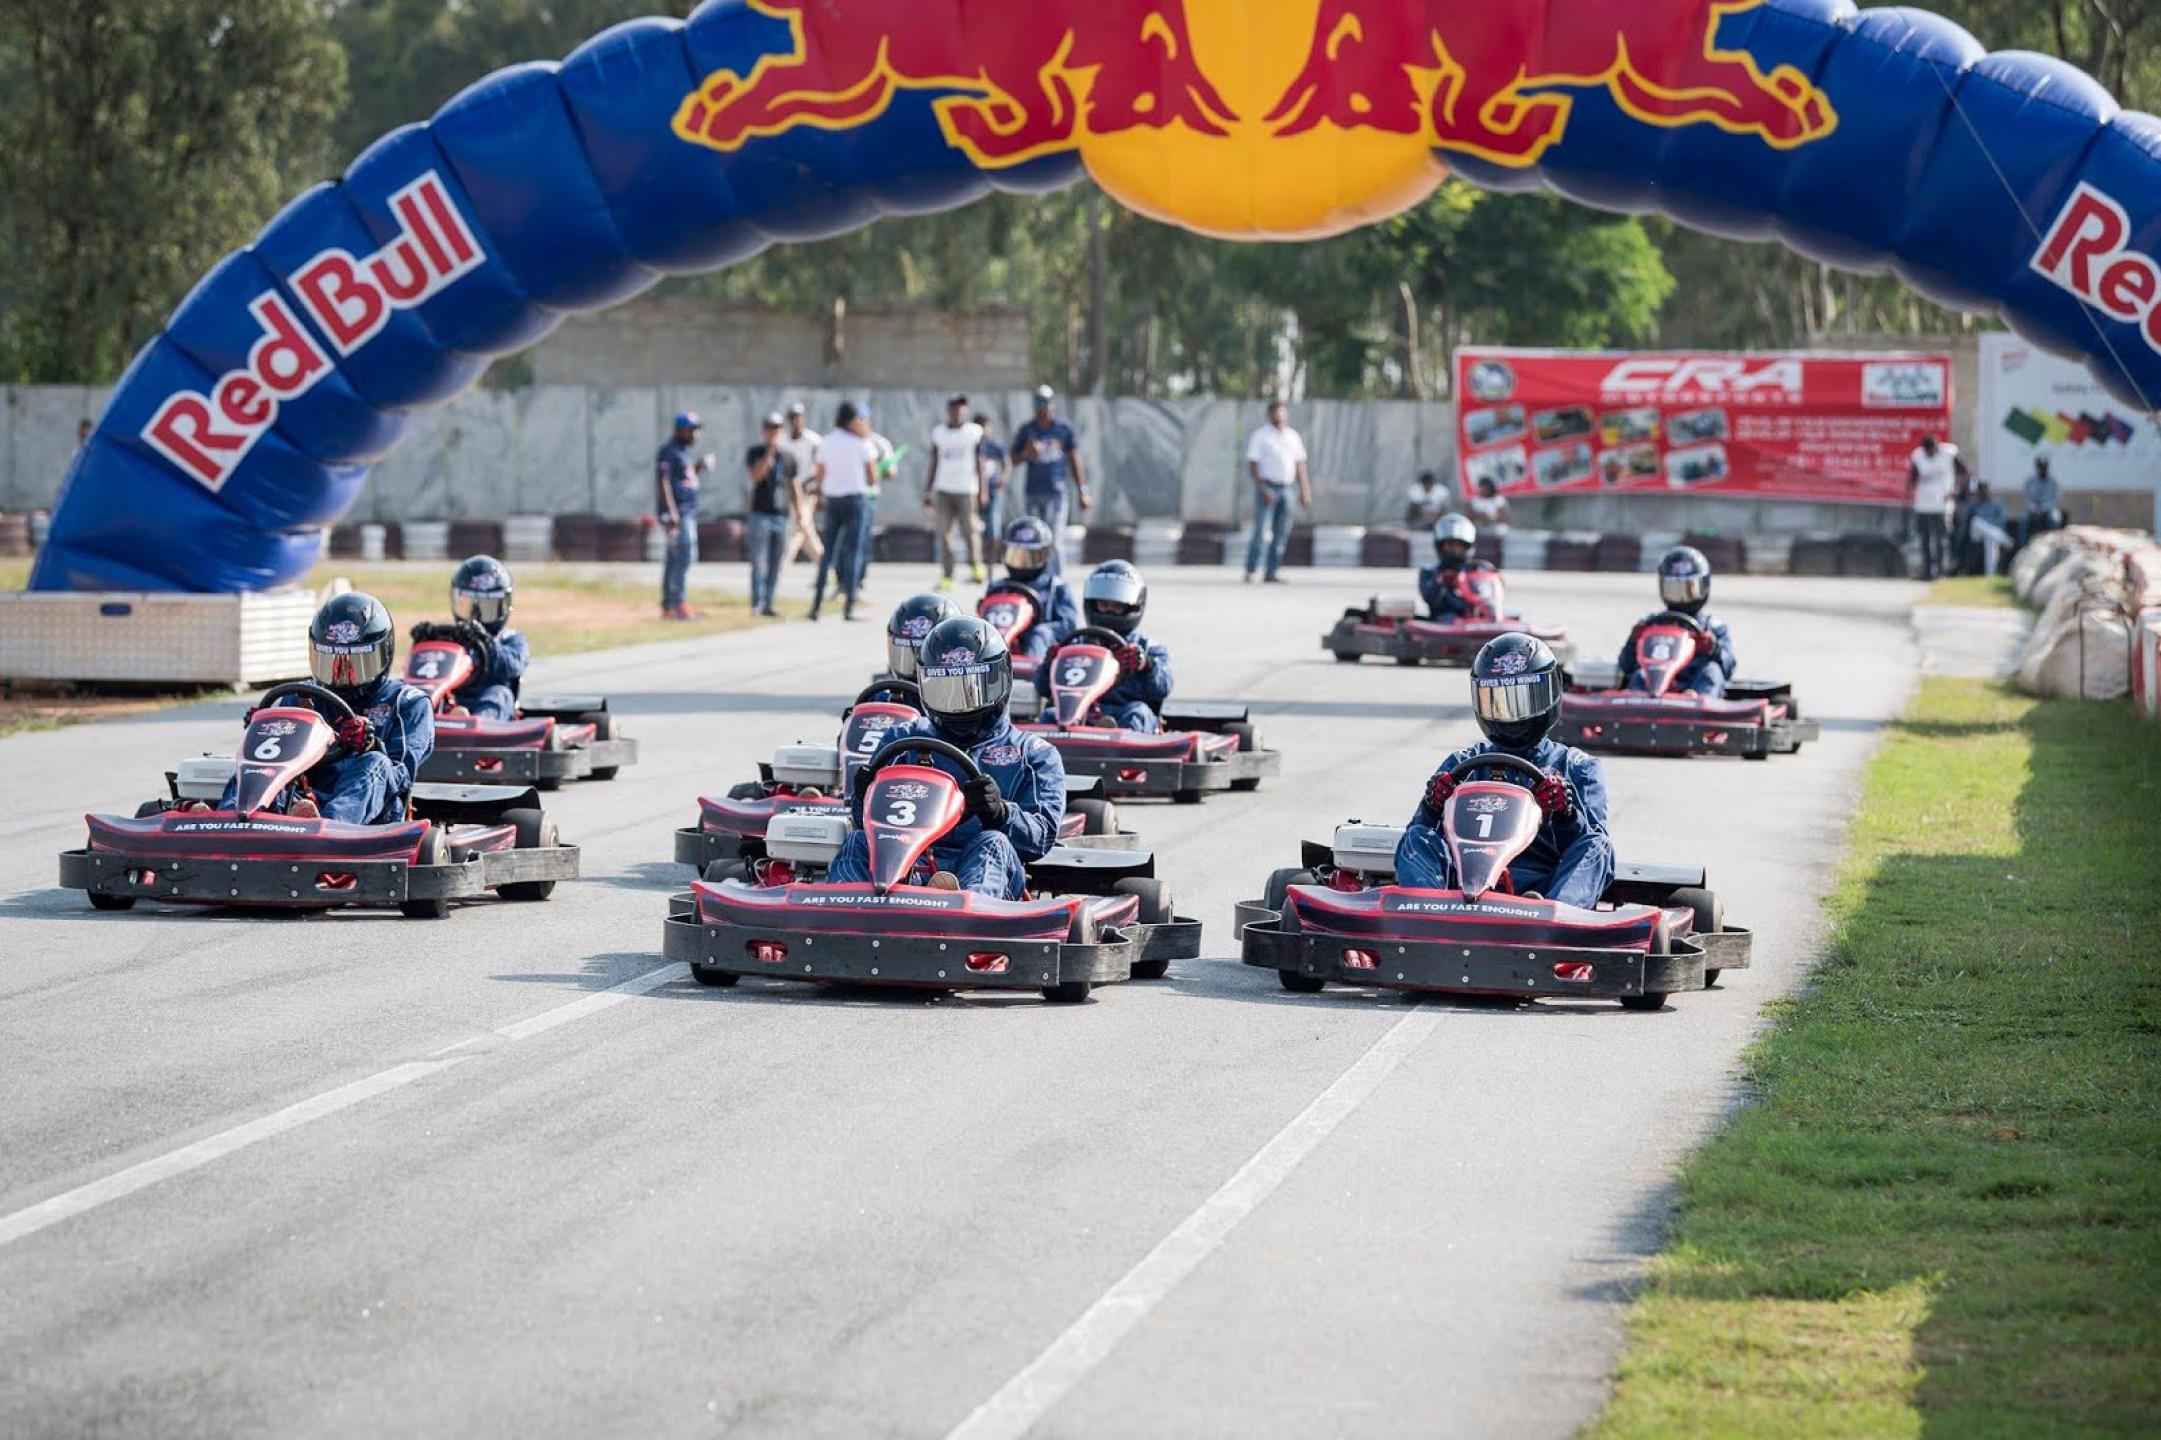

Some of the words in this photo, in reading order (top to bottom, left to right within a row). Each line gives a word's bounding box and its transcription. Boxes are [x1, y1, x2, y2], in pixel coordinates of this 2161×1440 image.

[149, 297, 326, 483] Red
[296, 179, 475, 350] Bull
[1601, 360, 1804, 391] CRA
[986, 611, 1014, 627] 10
[415, 661, 439, 678] 4
[927, 667, 946, 677] GIVES
[947, 667, 965, 675] YOU
[966, 664, 991, 674] WINGS
[1065, 667, 1087, 686] 9
[1480, 679, 1499, 687] GIVES
[1517, 675, 1541, 683] WINGS
[254, 736, 282, 760] 6
[858, 731, 885, 752] 5
[885, 800, 917, 826] 3
[175, 824, 197, 832] ARE
[199, 823, 222, 831] YOU
[223, 822, 250, 830] FAST
[1475, 813, 1494, 838] 1
[802, 897, 826, 905] ARE
[828, 896, 855, 904] YOU
[857, 896, 887, 904] FAST
[889, 897, 949, 909] ENOUGH?
[1397, 903, 1420, 911] ARE
[1423, 903, 1449, 911] YOU
[1450, 904, 1480, 912] FAST
[1481, 904, 1540, 918] ENOUGH?
